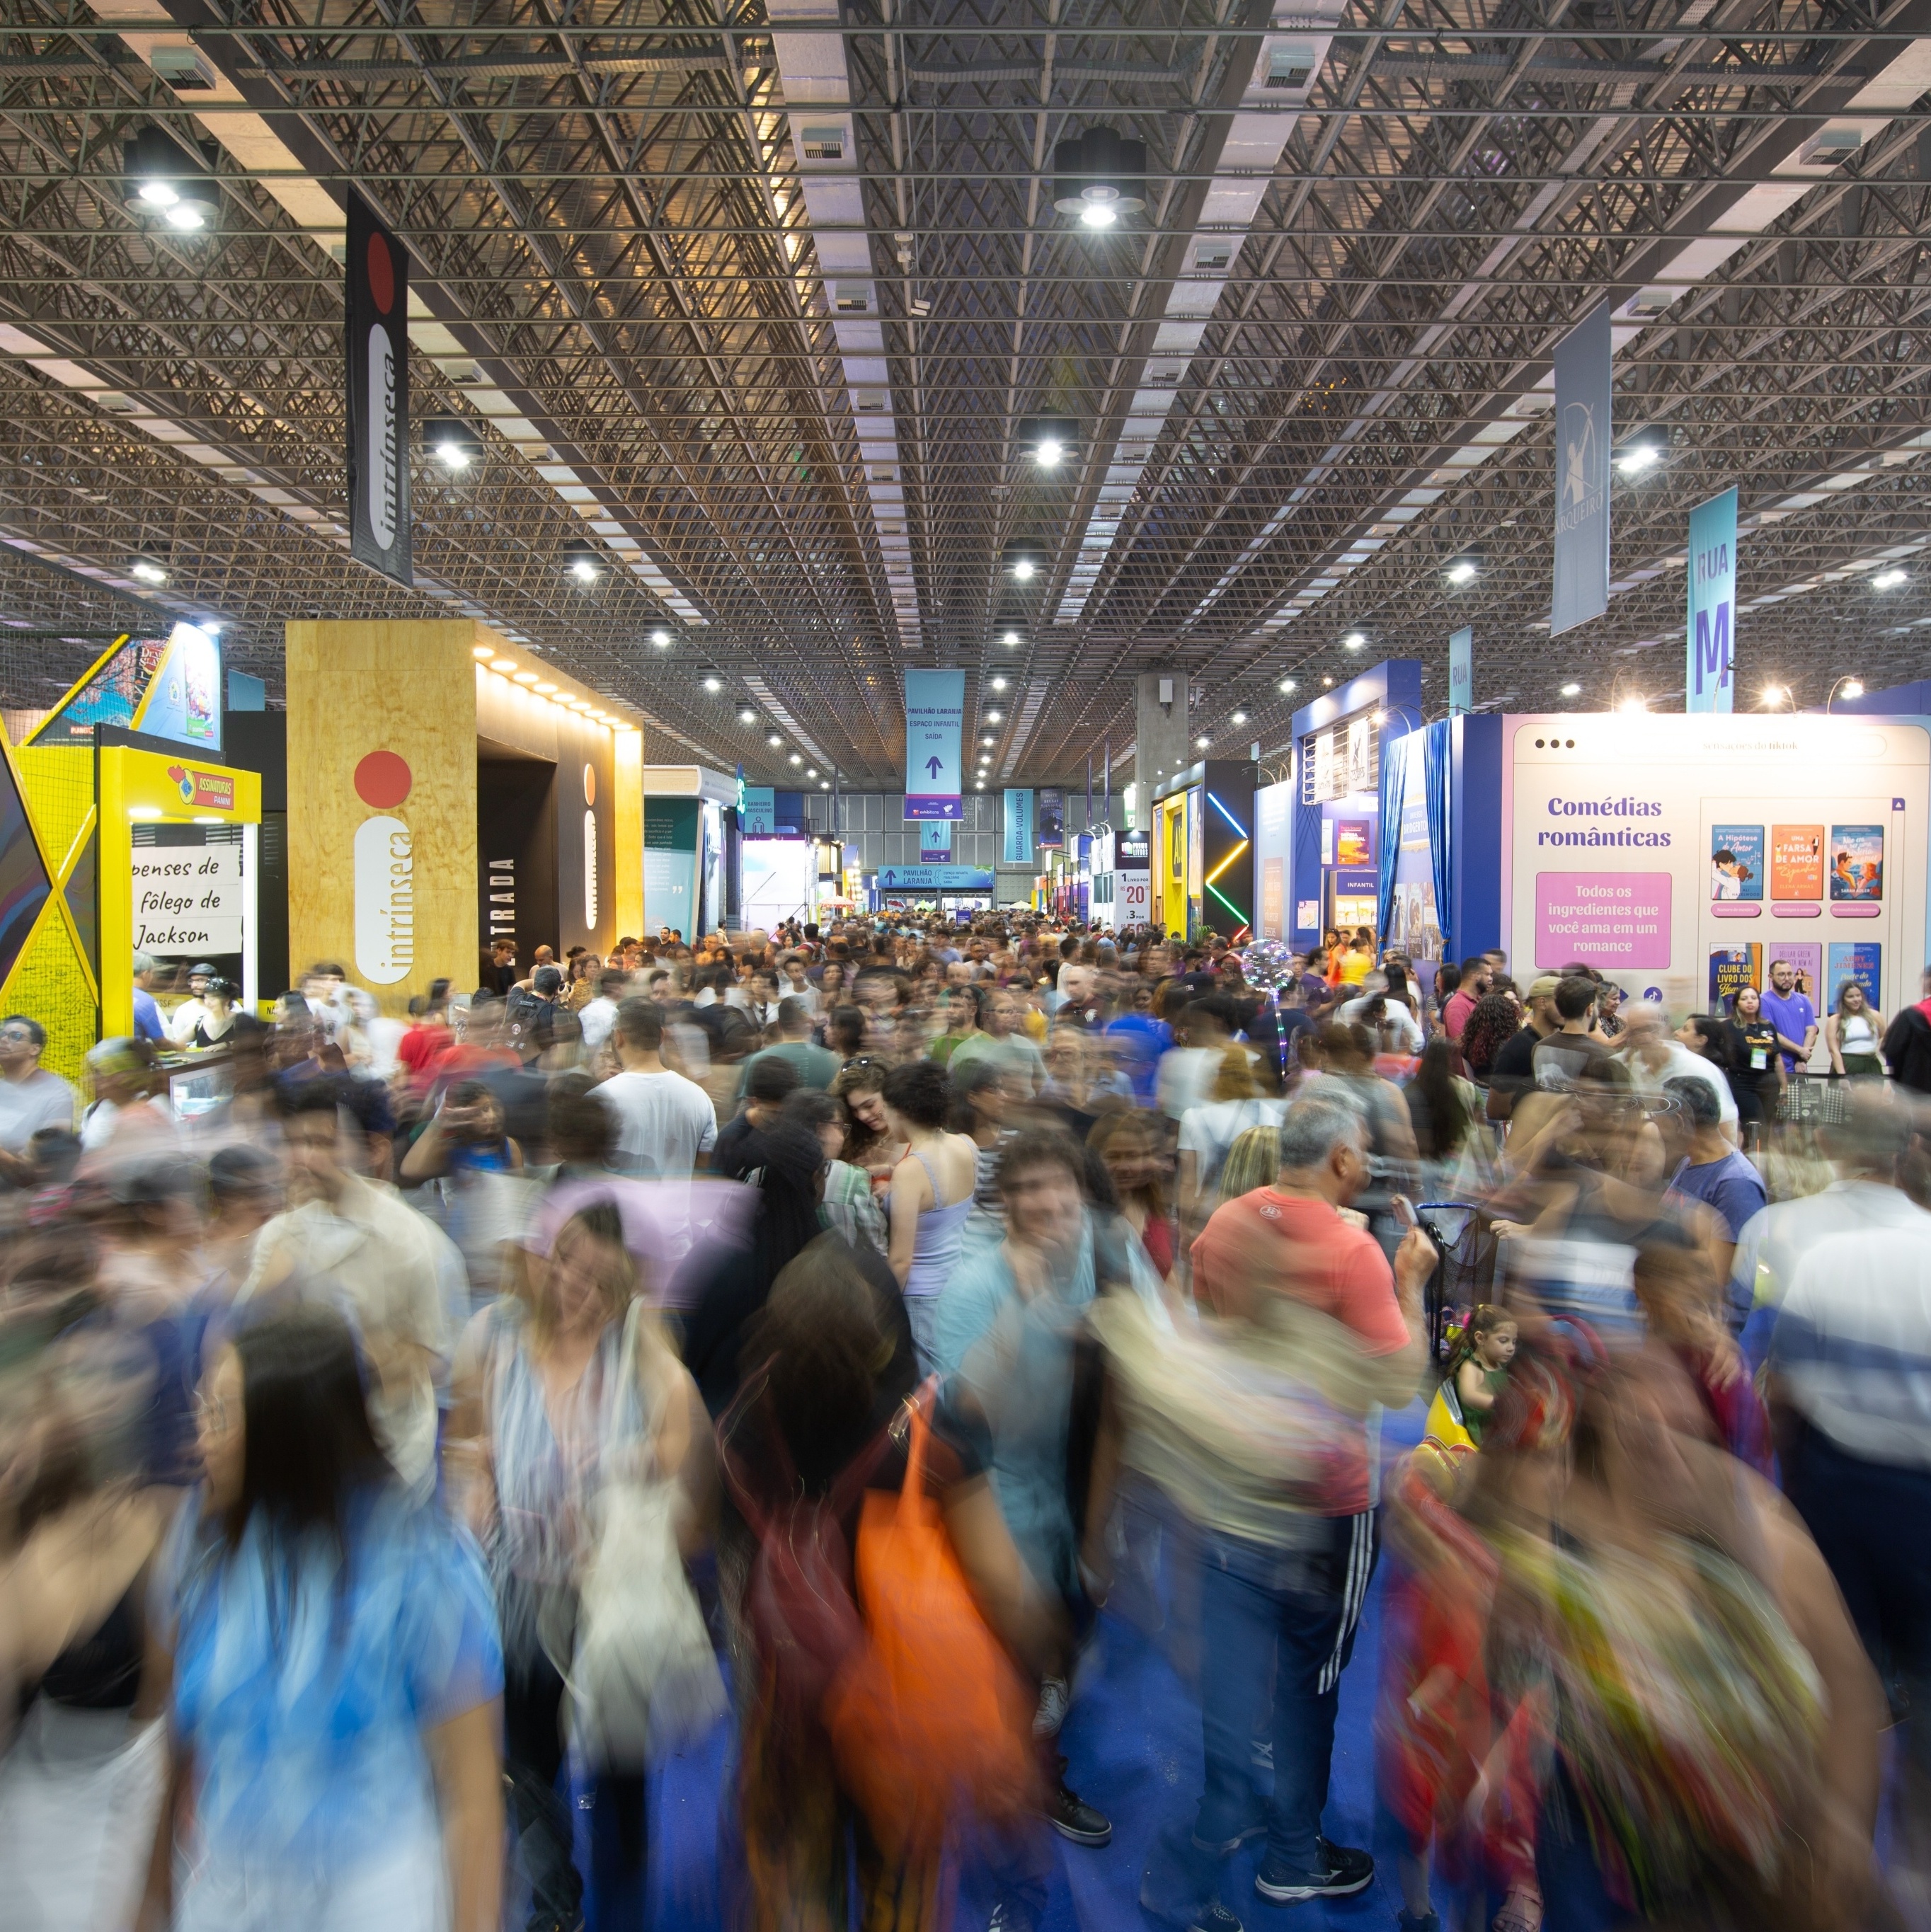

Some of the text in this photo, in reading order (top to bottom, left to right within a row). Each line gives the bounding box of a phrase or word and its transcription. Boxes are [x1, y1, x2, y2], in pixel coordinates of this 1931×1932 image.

[380, 352, 396, 533] intrínseca
[1555, 491, 1603, 535] ARQUEIRO
[1698, 544, 1728, 585] RUA
[1696, 601, 1729, 696] M
[1452, 662, 1467, 687] RUA
[1703, 742, 1753, 751] sensações
[1769, 741, 1798, 749] tiktok
[198, 778, 231, 795] ASSINATURAS
[214, 796, 231, 806] PANINI
[1547, 796, 1662, 817] Comédias
[1538, 827, 1671, 847] românticas
[1731, 841, 1753, 853] Amor
[1783, 844, 1811, 853] FARSA
[198, 856, 219, 875] de
[1775, 854, 1819, 863] DE AMOR
[1121, 873, 1127, 882] 1
[379, 832, 414, 967] intrínseca
[1126, 885, 1145, 904] 20
[1575, 885, 1632, 897] Todos os
[141, 890, 220, 914] fôlego de
[489, 859, 515, 965] TRADA
[1129, 910, 1135, 919] 3
[1548, 903, 1658, 919] ingredientes que
[1548, 921, 1658, 934] você ama em um
[133, 924, 209, 950] Jackson
[1573, 941, 1633, 952] romance
[1719, 965, 1752, 973] CLUBE DO
[1717, 974, 1753, 983] LIVRO DOS
